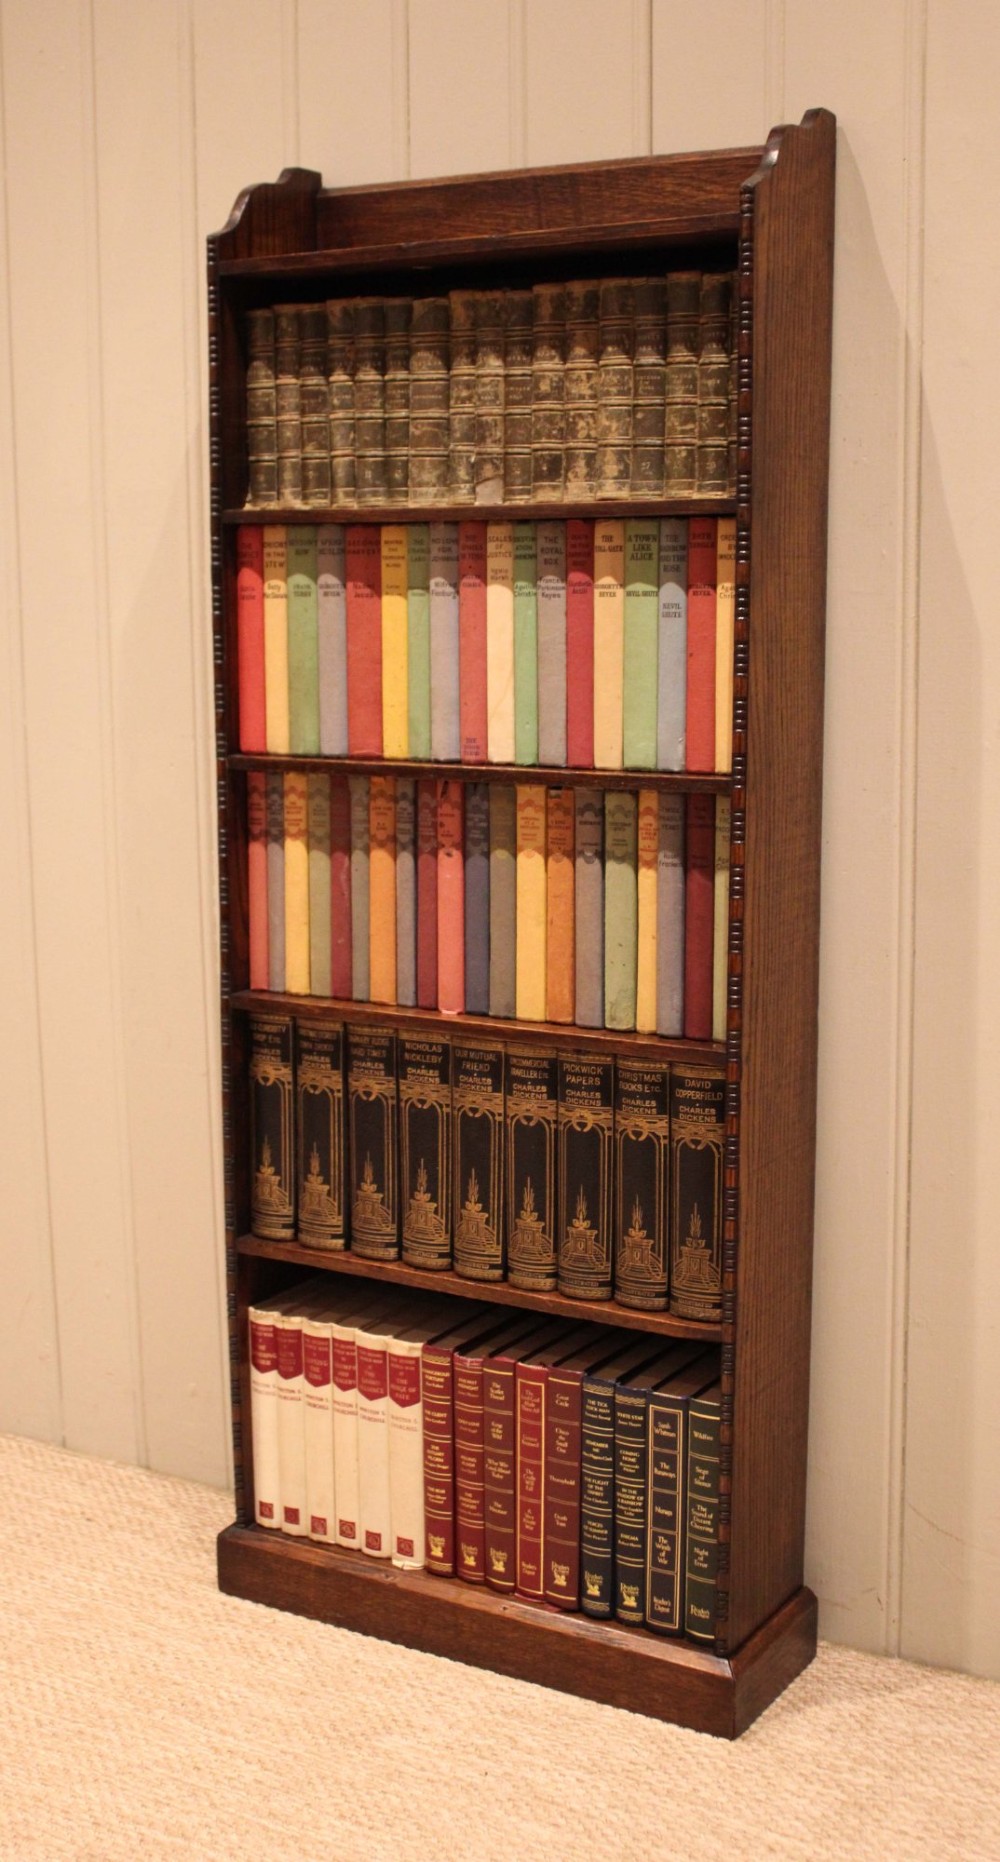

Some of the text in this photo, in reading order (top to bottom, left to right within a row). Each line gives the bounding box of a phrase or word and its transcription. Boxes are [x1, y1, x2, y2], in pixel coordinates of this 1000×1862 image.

[544, 536, 559, 544] THE
[633, 534, 658, 542] TOWN
[540, 547, 565, 555] ROYAL
[630, 552, 654, 561] ALICE
[405, 1042, 442, 1053] NICHOLAS
[405, 1052, 443, 1063] NICKLEBY
[455, 1050, 498, 1062] OUR MUTUAL
[352, 1060, 385, 1069] CHARLES
[462, 1061, 490, 1072] FRIEND
[563, 1063, 604, 1075] PICKWICK
[353, 1067, 385, 1076] DICKENS
[407, 1067, 439, 1076] CHARLES
[618, 1070, 662, 1083] CHRISTMAS
[407, 1075, 439, 1084] DICKENS
[459, 1075, 492, 1085] CHARLES
[566, 1074, 601, 1085] PAPERS
[684, 1079, 712, 1089] DAVID
[459, 1083, 492, 1092] DICKENS
[513, 1083, 547, 1092] CHARLES
[619, 1080, 643, 1092] BOOKS
[513, 1091, 547, 1100] DICKENS
[566, 1089, 601, 1099] CHARLES
[676, 1088, 723, 1101] COPPERFIELD
[566, 1097, 601, 1106] DICKENS
[622, 1097, 657, 1107] CHARLES
[622, 1105, 657, 1115] DICKENS
[679, 1105, 717, 1115] CHARLES
[679, 1113, 717, 1123] DICKENS
